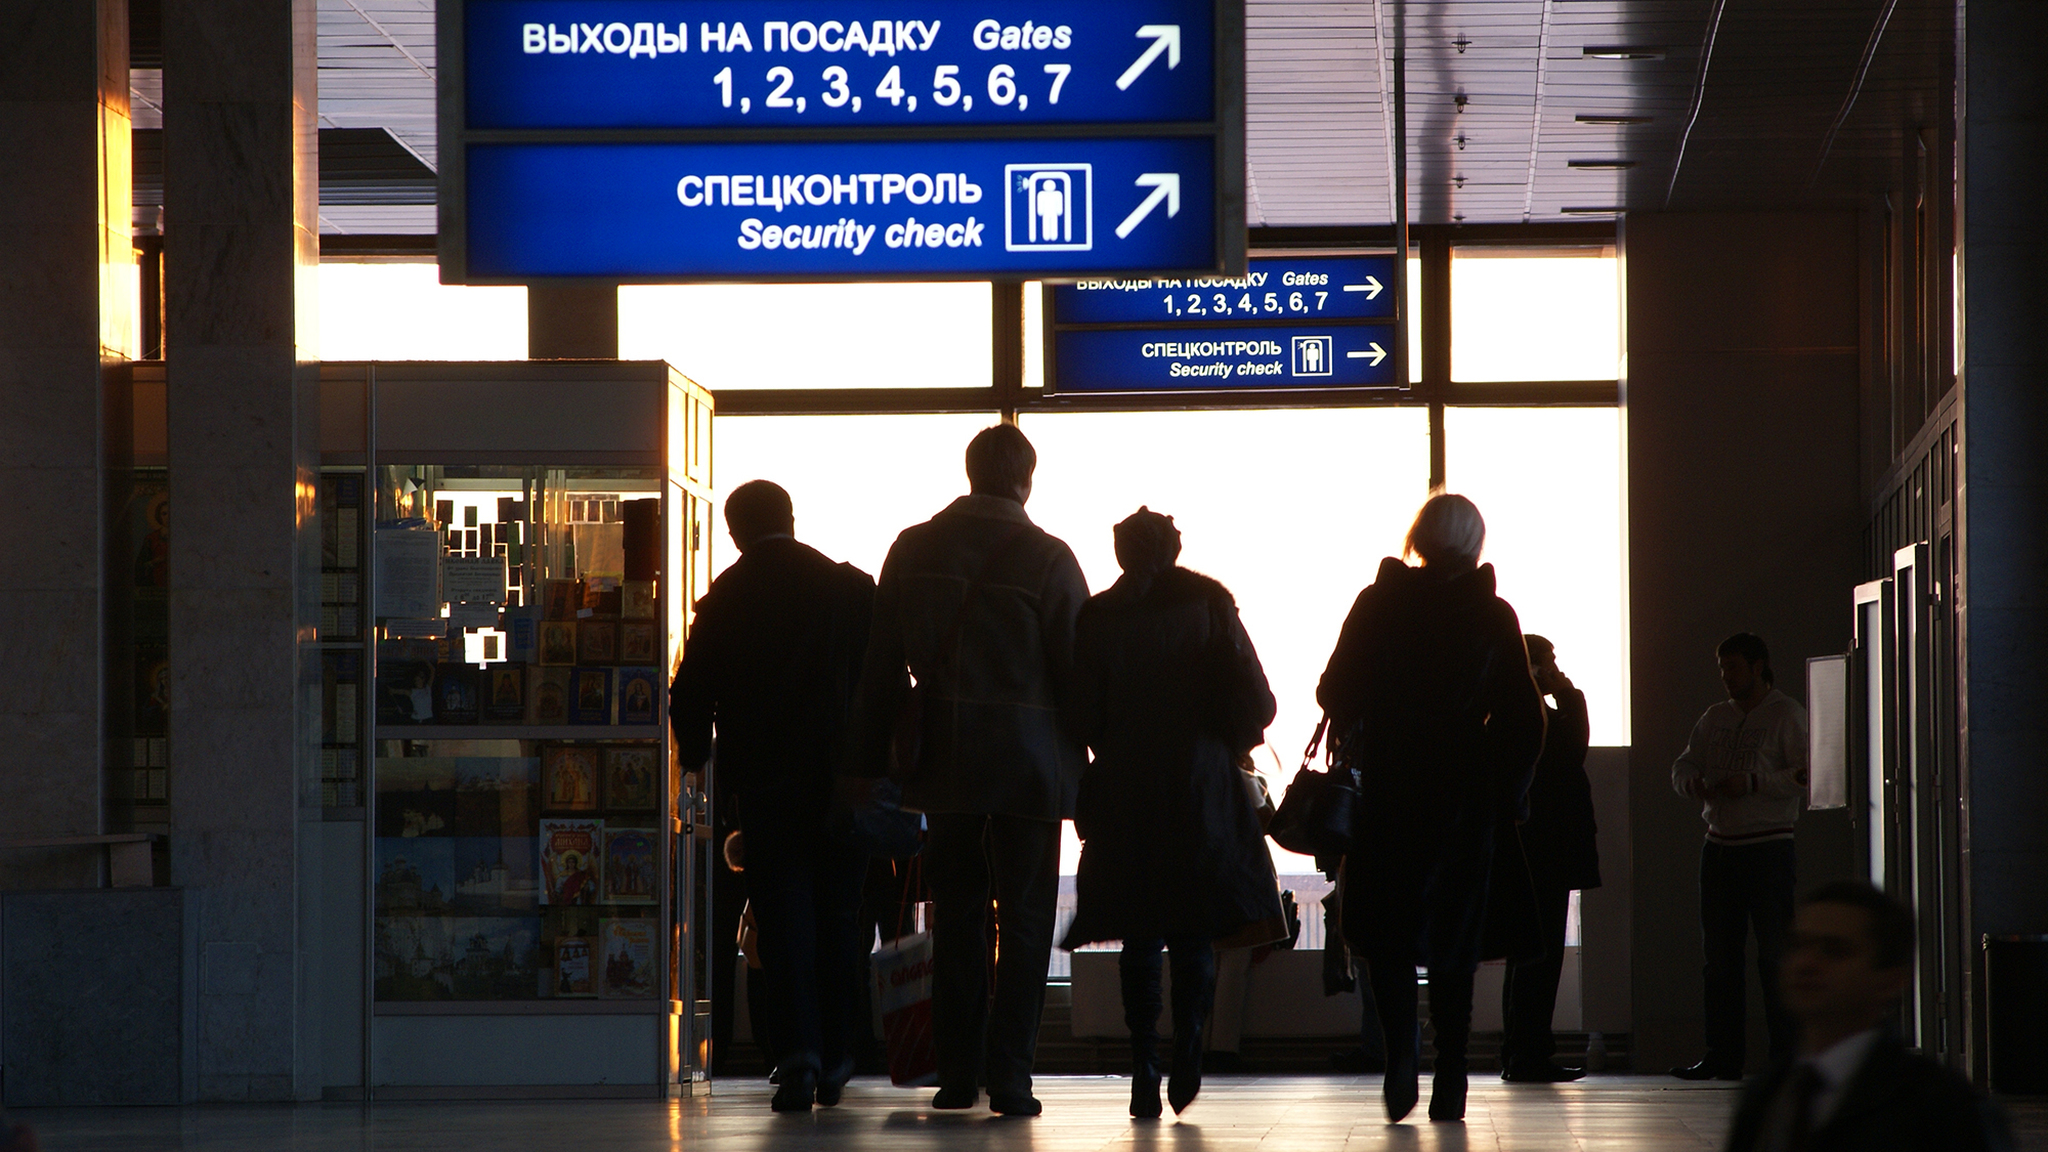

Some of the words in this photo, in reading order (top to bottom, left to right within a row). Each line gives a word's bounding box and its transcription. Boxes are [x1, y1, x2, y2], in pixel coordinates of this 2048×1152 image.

[522, 22, 688, 58] ВЫХОДЫ
[700, 21, 753, 53] НА
[763, 20, 941, 57] ПОСАДКУ
[972, 18, 1073, 51] Gates
[713, 66, 751, 114] 1,
[765, 65, 807, 114] 2,
[821, 65, 862, 113] 3,
[875, 65, 918, 113] 4,
[932, 64, 973, 112] 5,
[987, 63, 1028, 112] 6,
[1043, 63, 1072, 105] 7
[676, 172, 983, 213] СПЕЦКОНТРОЛЬ
[737, 217, 876, 256] Security
[884, 216, 985, 249] check
[1282, 271, 1329, 286] Gates
[1163, 294, 1182, 317] 1,
[1187, 293, 1207, 316] 2,
[1212, 293, 1233, 316] 3,
[1237, 292, 1258, 315] 4,
[1263, 292, 1284, 315] 5,
[1289, 291, 1309, 314] 6,
[1314, 291, 1329, 311] 7
[1141, 340, 1282, 360] СПЕЦКОНТРОЛЬ
[1169, 361, 1234, 380] Security
[1236, 360, 1284, 376] check
